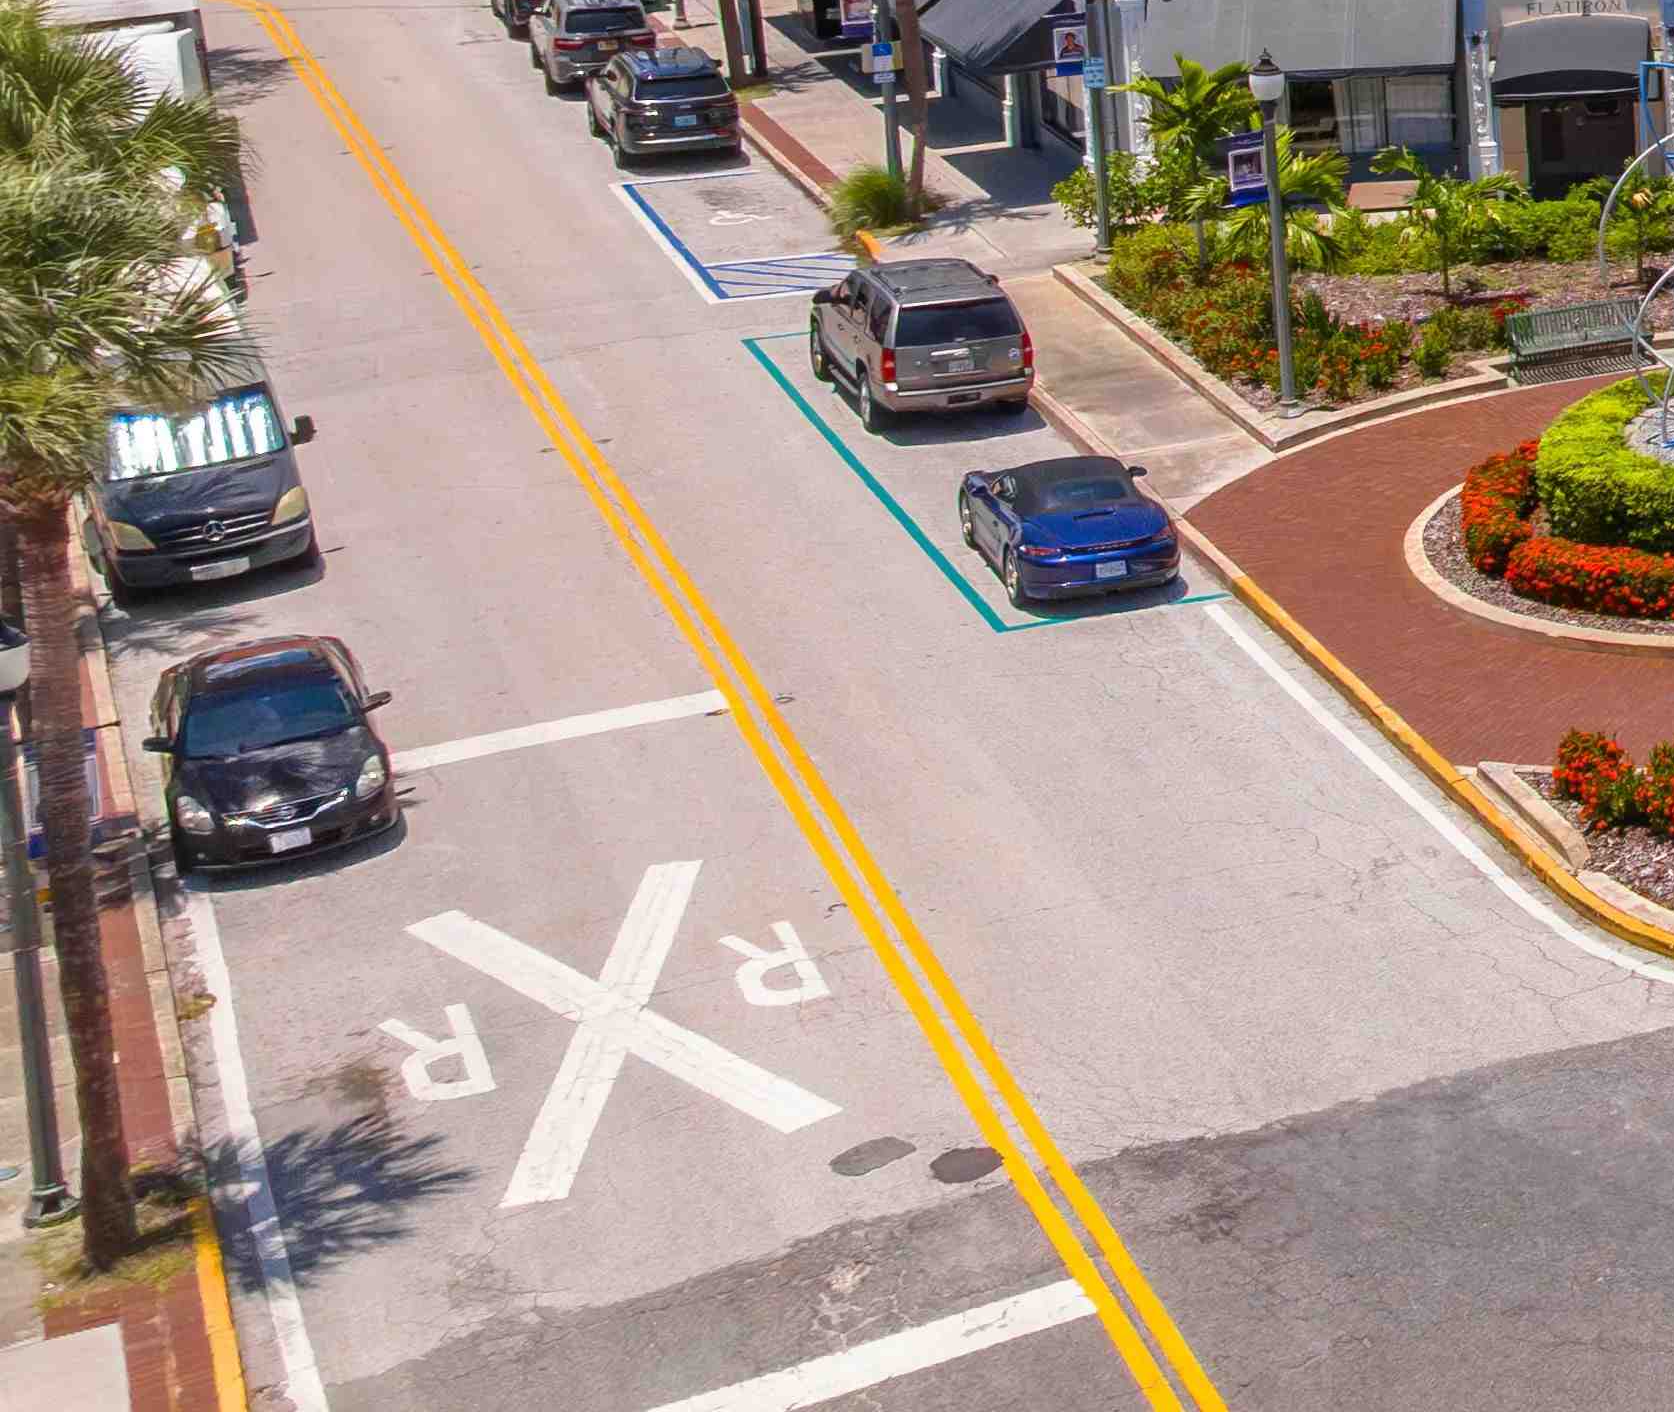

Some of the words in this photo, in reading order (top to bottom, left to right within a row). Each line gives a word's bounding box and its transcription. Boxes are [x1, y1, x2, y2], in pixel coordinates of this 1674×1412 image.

[1527, 0, 1622, 16] FLATIRON
[377, 1003, 496, 1101] R
[718, 920, 831, 1006] R
